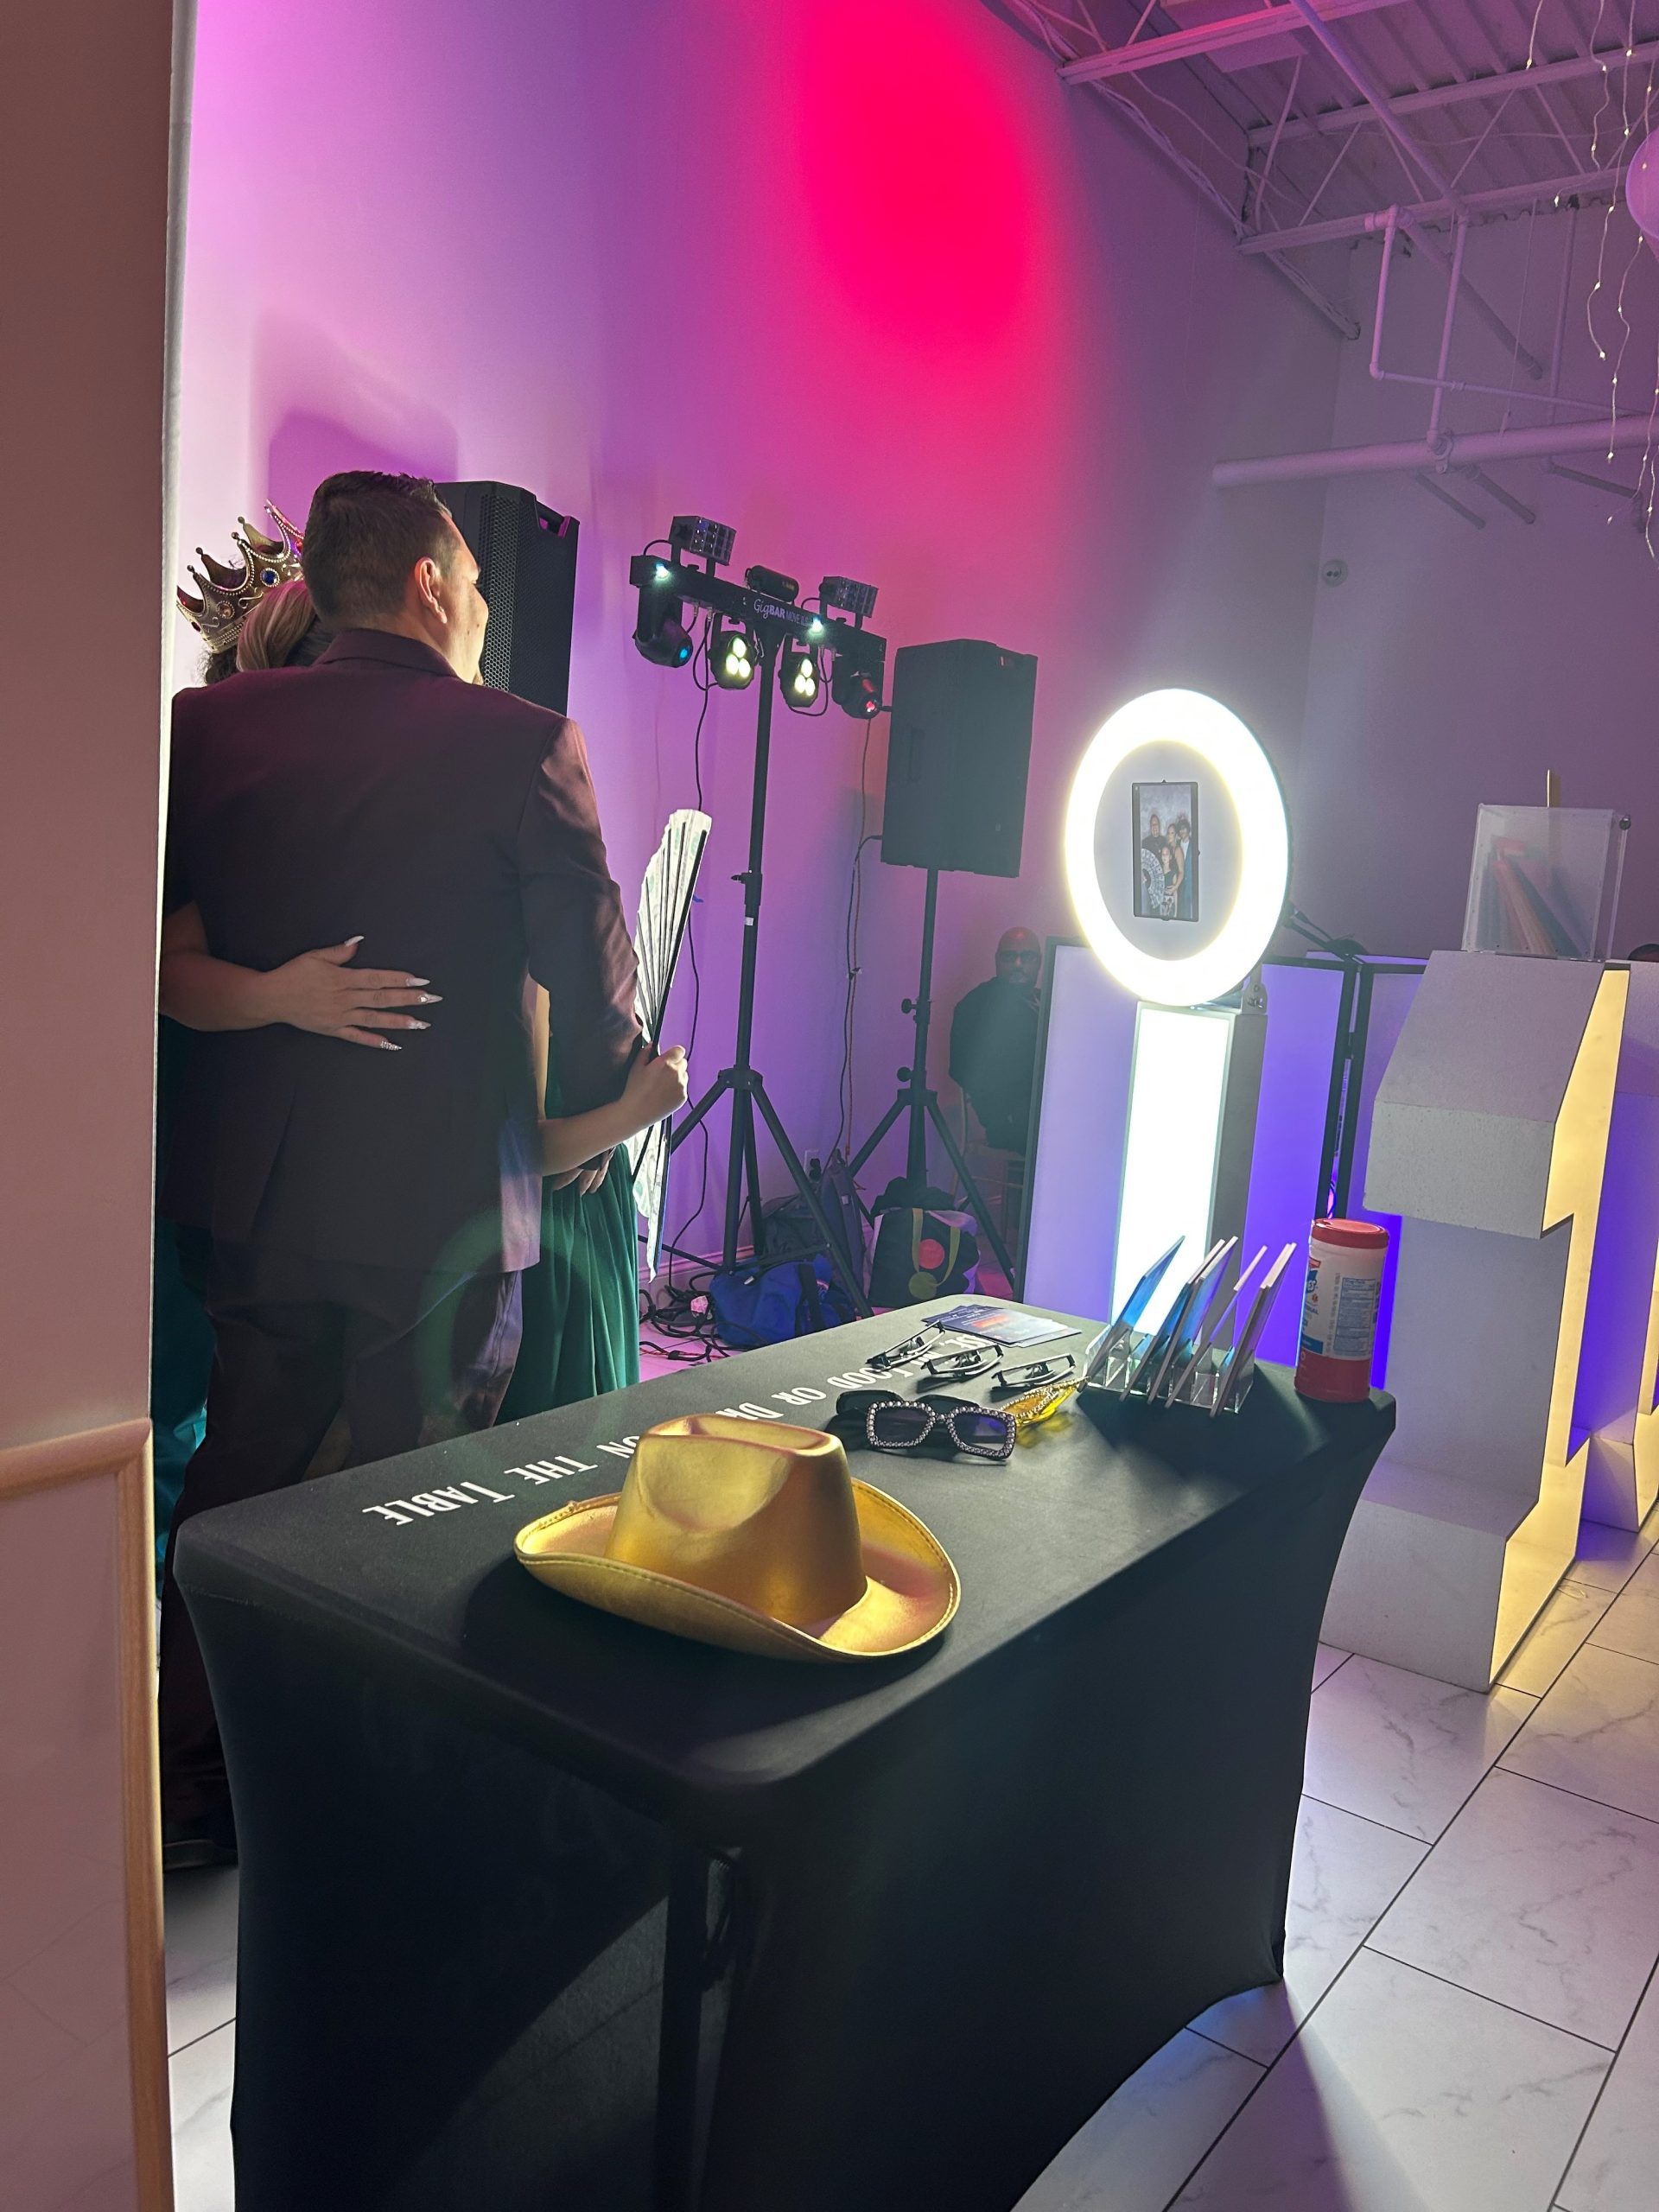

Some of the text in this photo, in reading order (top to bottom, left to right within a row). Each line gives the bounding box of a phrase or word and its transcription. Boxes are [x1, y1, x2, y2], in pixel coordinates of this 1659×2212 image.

[775, 1387, 827, 1406] OR
[503, 1455, 599, 1485] THE
[361, 1481, 516, 1526] TABLE
